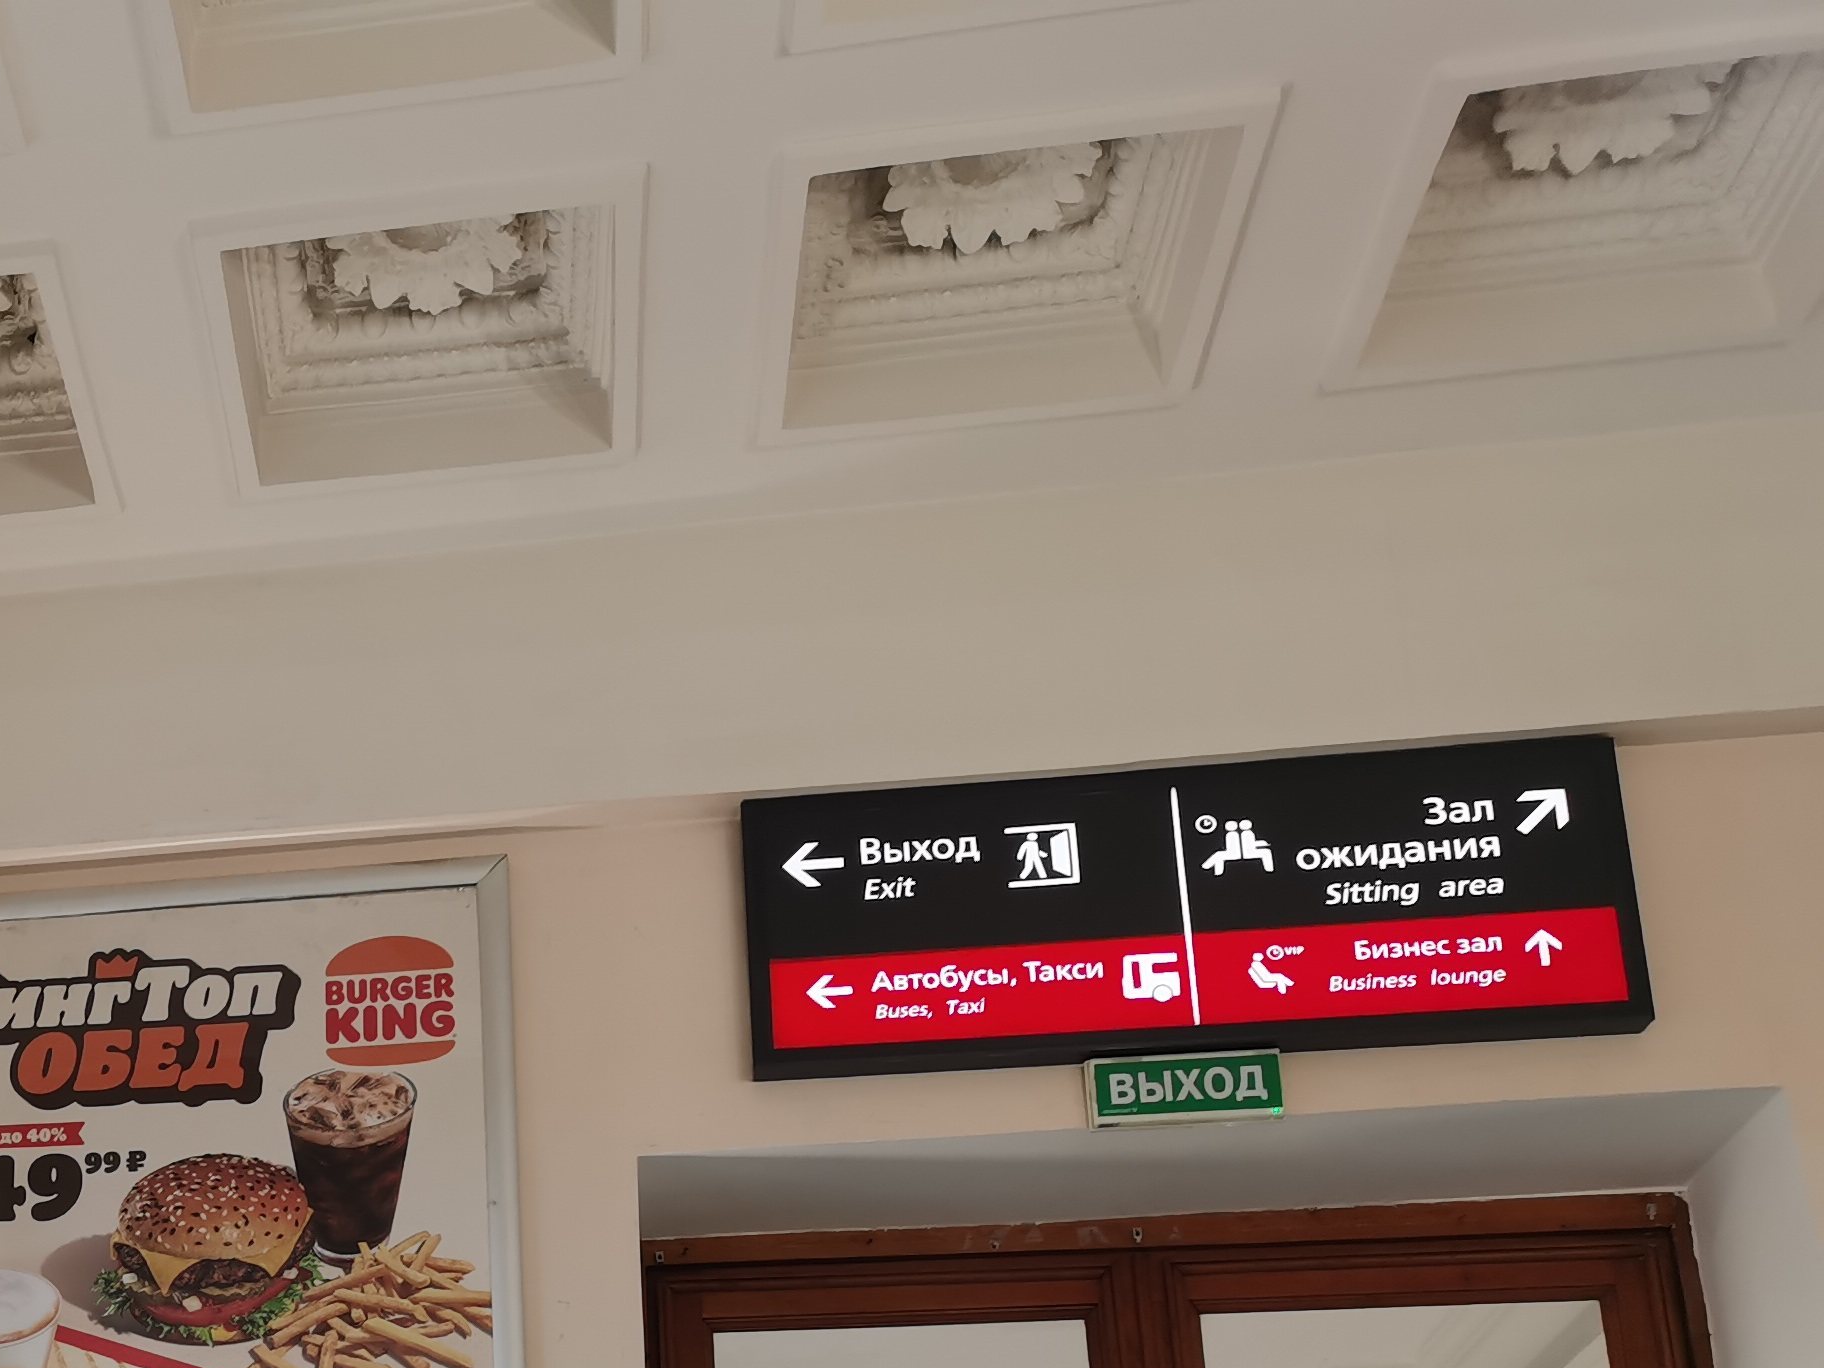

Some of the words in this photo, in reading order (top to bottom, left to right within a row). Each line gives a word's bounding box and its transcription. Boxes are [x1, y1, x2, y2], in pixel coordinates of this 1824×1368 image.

[1423, 797, 1495, 825] Зал
[859, 834, 980, 865] Выход
[1295, 836, 1501, 871] ожидания
[863, 876, 916, 900] Exit
[1325, 880, 1420, 907] Sitting
[1438, 876, 1504, 898] area
[1354, 940, 1450, 961] Бизнес
[1456, 936, 1503, 953] зал
[325, 973, 455, 1004] BURGER
[871, 965, 1017, 993] Автобусы,
[1022, 960, 1104, 983] Такси
[1329, 974, 1417, 992] Business
[1430, 968, 1506, 988] lounge
[325, 1000, 456, 1044] KING
[875, 1001, 933, 1020] Buses,
[946, 997, 985, 1015] Taxi
[17, 1022, 251, 1095] ОБЕД
[1109, 1065, 1268, 1105] ВЫХОД
[0, 1131, 22, 1144] до
[27, 1127, 68, 1143] 40%
